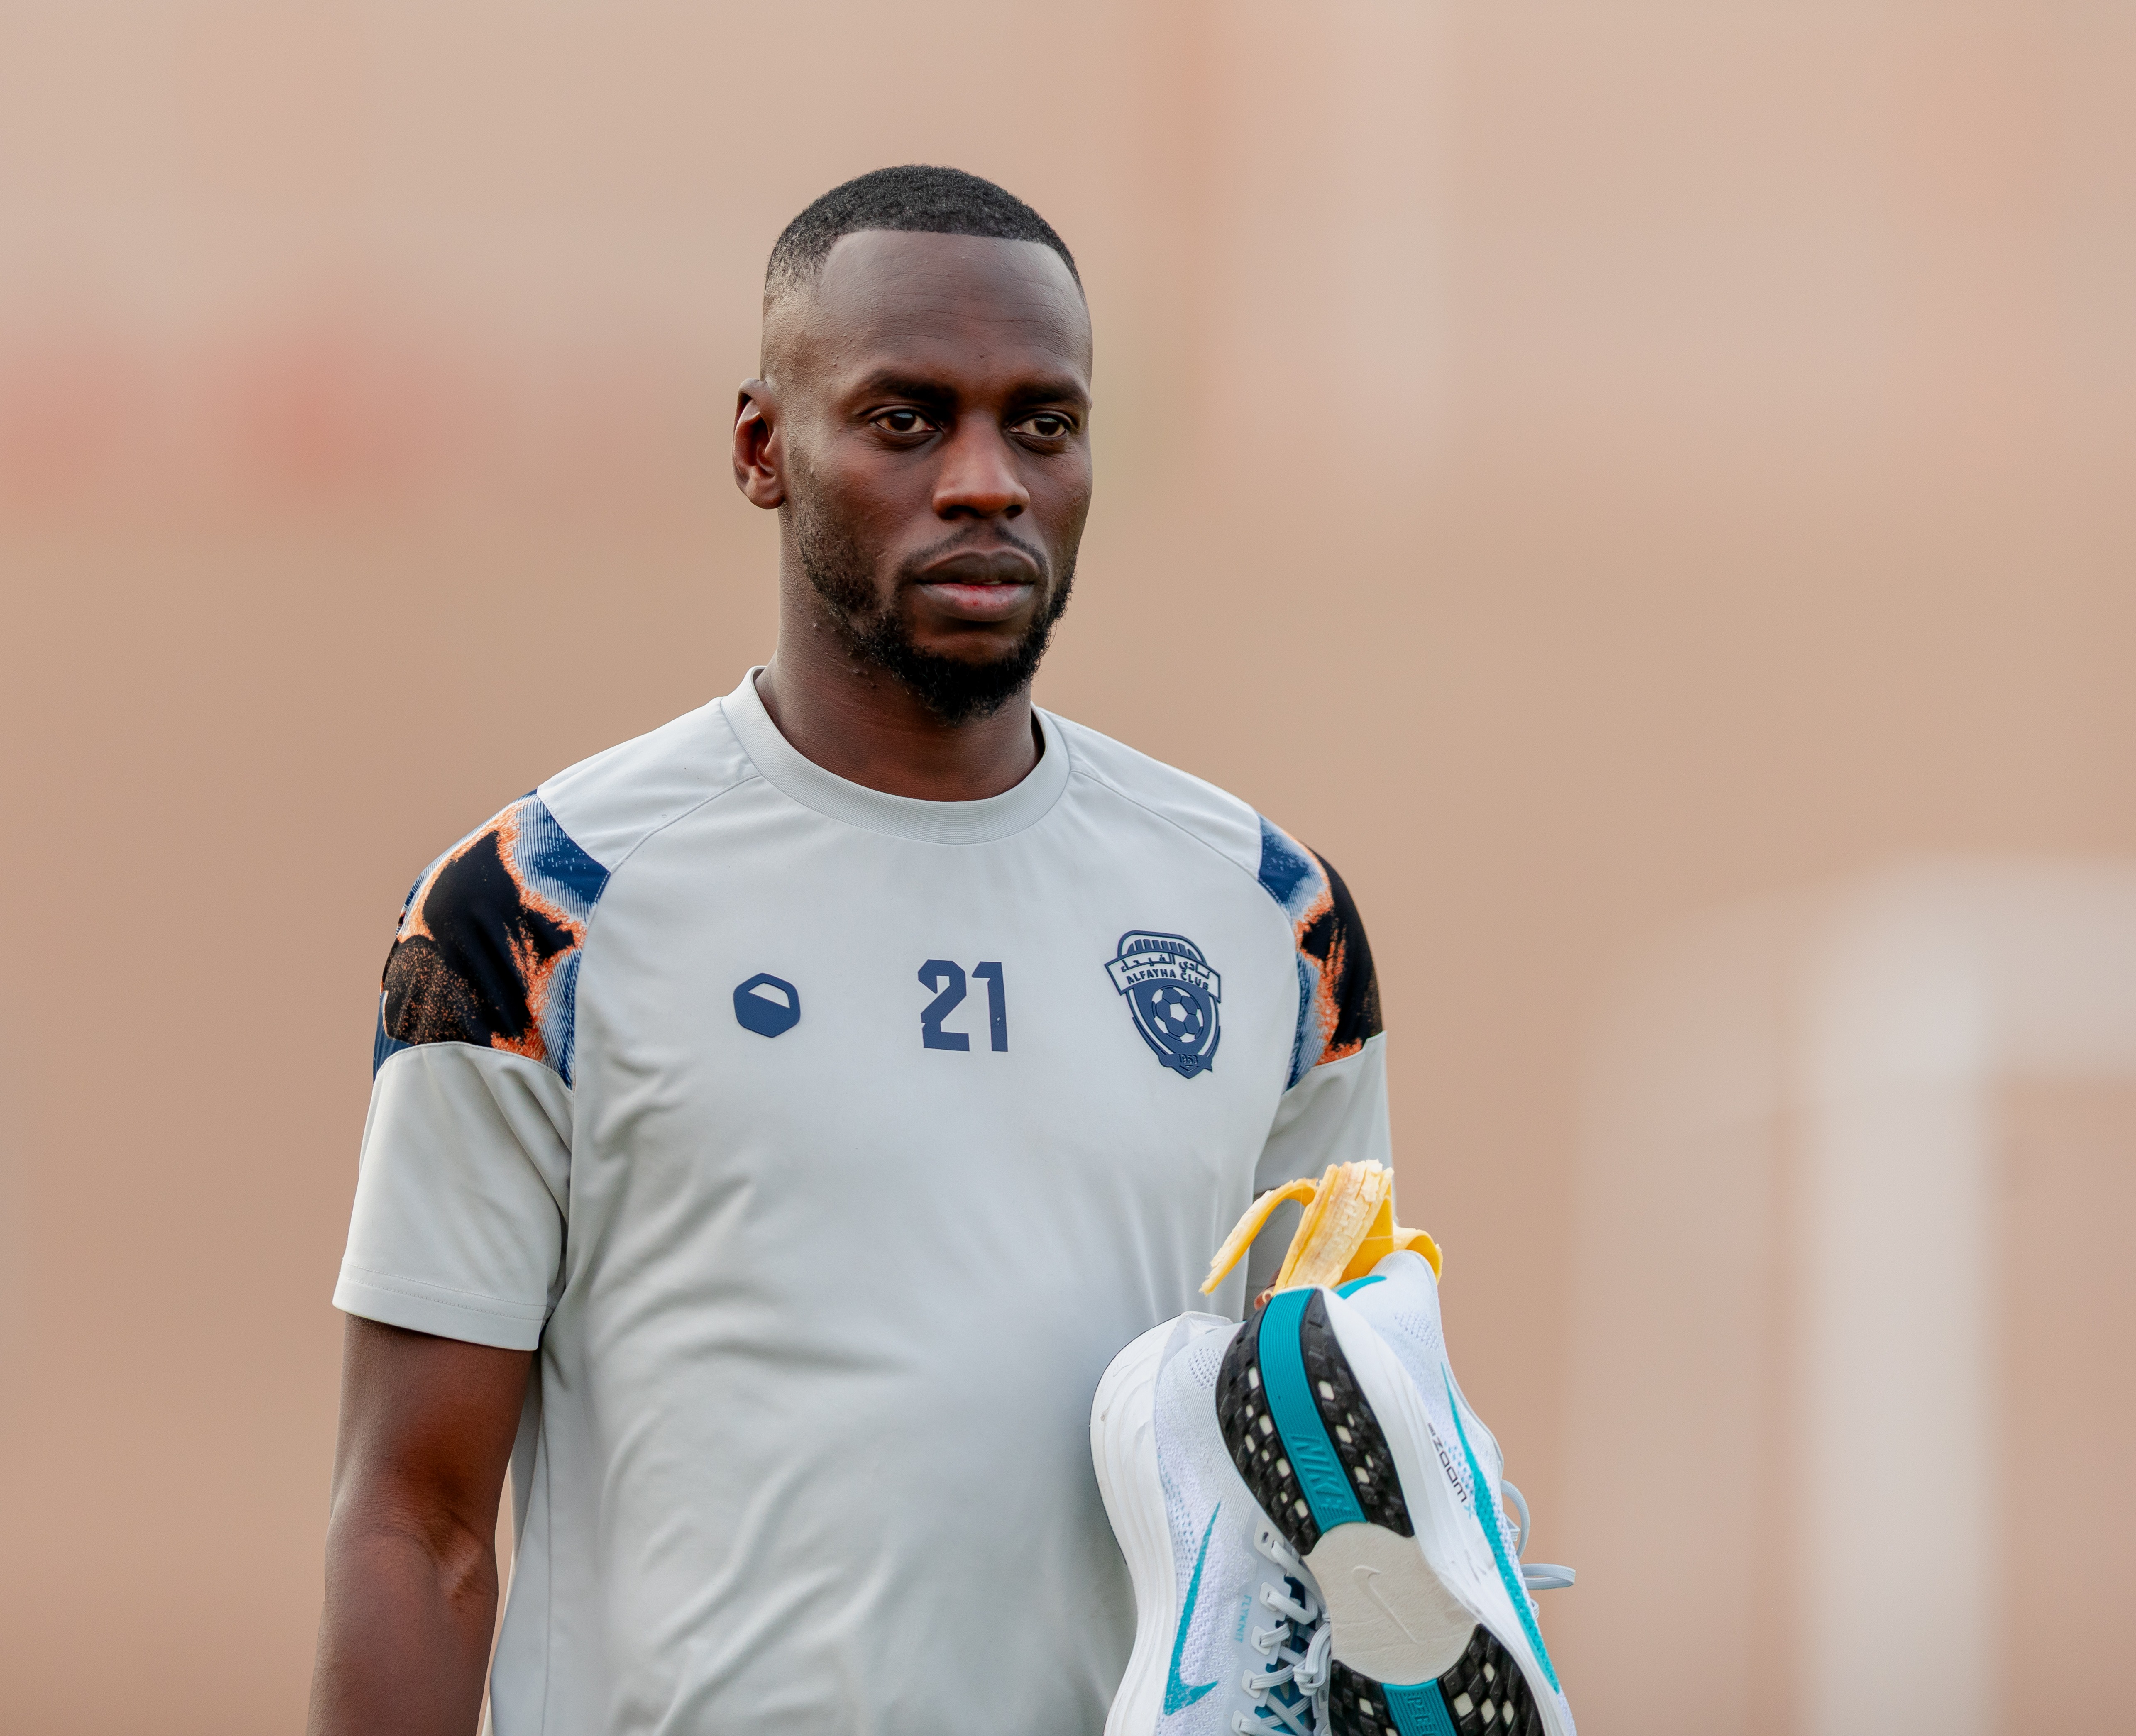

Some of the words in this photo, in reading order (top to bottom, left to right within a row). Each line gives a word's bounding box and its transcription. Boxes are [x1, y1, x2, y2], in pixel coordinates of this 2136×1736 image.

[1121, 953, 1176, 972] الفيحاء
[1126, 968, 1176, 985] ALFAYHA
[1180, 972, 1209, 990] CLUB
[1178, 961, 1210, 979] نادي
[918, 959, 1008, 1052] 21
[1290, 1433, 1350, 1510] NIKE
[1234, 1594, 1252, 1643] FLYKNIT
